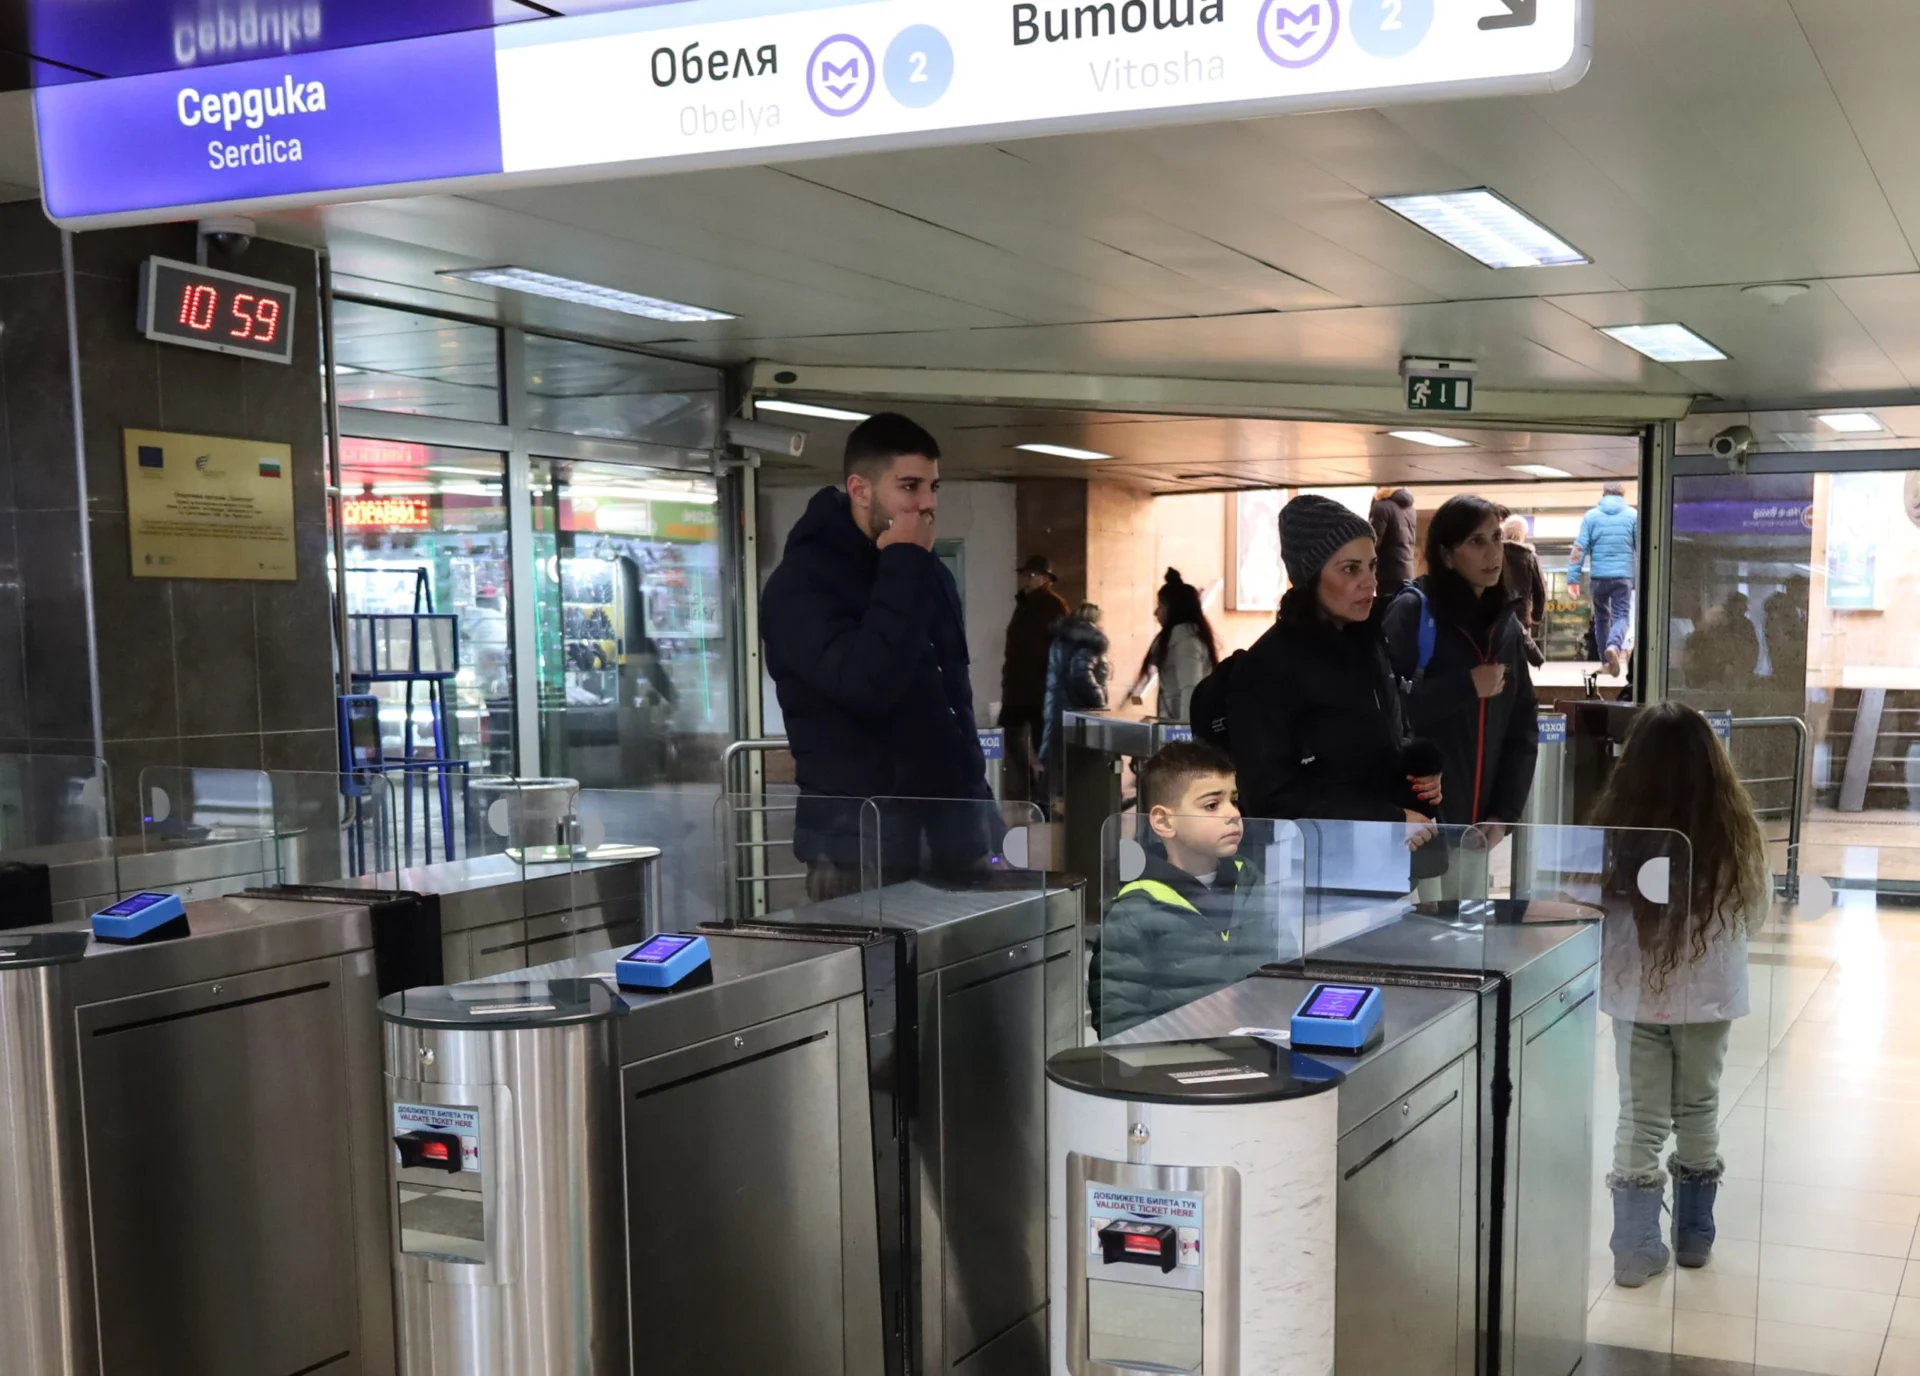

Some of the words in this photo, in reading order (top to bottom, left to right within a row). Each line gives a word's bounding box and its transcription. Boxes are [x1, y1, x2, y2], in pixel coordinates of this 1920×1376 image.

[1012, 0, 1225, 46] Витоша
[1381, 0, 1403, 31] 2
[651, 41, 778, 87] Обеля
[908, 51, 928, 83] 2
[1088, 50, 1225, 92] Vitosha
[177, 74, 327, 131] Сердика
[679, 100, 781, 136] Obelya
[208, 134, 303, 170] Serdica
[179, 285, 218, 330] 10
[230, 293, 280, 342] 59
[979, 737, 1000, 748] ХОД
[1171, 732, 1194, 742] ИЗХ
[1538, 723, 1566, 732] ИЗХОД
[398, 1106, 436, 1116] ДОБЛИЖЕТЕ
[437, 1110, 461, 1118] БИЛЕТА
[400, 1113, 430, 1123] VALIDATE
[432, 1117, 453, 1126] TICKET
[455, 1119, 472, 1128] HERE
[1093, 1192, 1145, 1204] ДОБЛИЖЕТЕ
[1146, 1197, 1180, 1207] БИЛЕТА
[1182, 1201, 1197, 1209] ТУК
[1095, 1200, 1136, 1211] VALIDATE
[1137, 1204, 1168, 1215] TICKET
[1169, 1208, 1194, 1217] HERE
